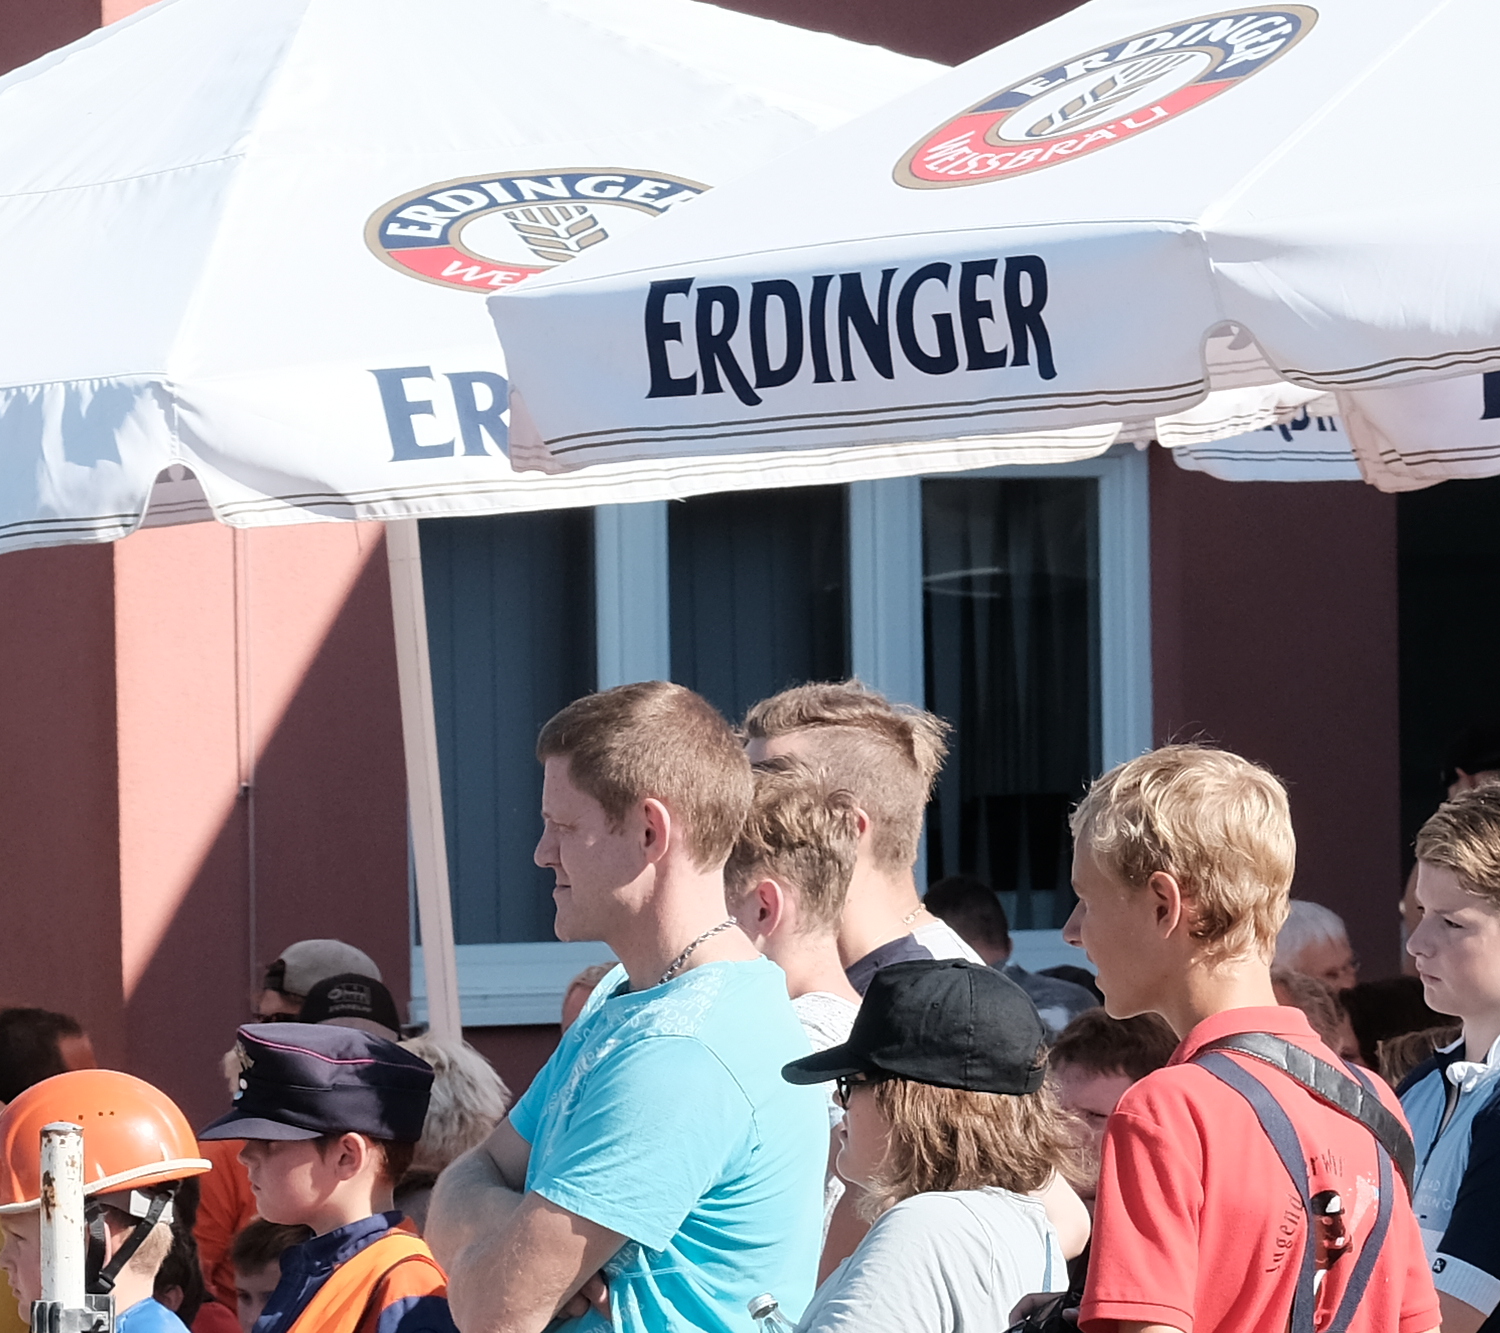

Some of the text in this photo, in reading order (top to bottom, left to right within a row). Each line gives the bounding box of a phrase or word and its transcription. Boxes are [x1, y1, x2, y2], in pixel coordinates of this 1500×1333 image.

[1011, 13, 1293, 98] ERDINGER
[922, 106, 1169, 176] WEISSBRÄU
[645, 255, 1057, 406] ERDINGER
